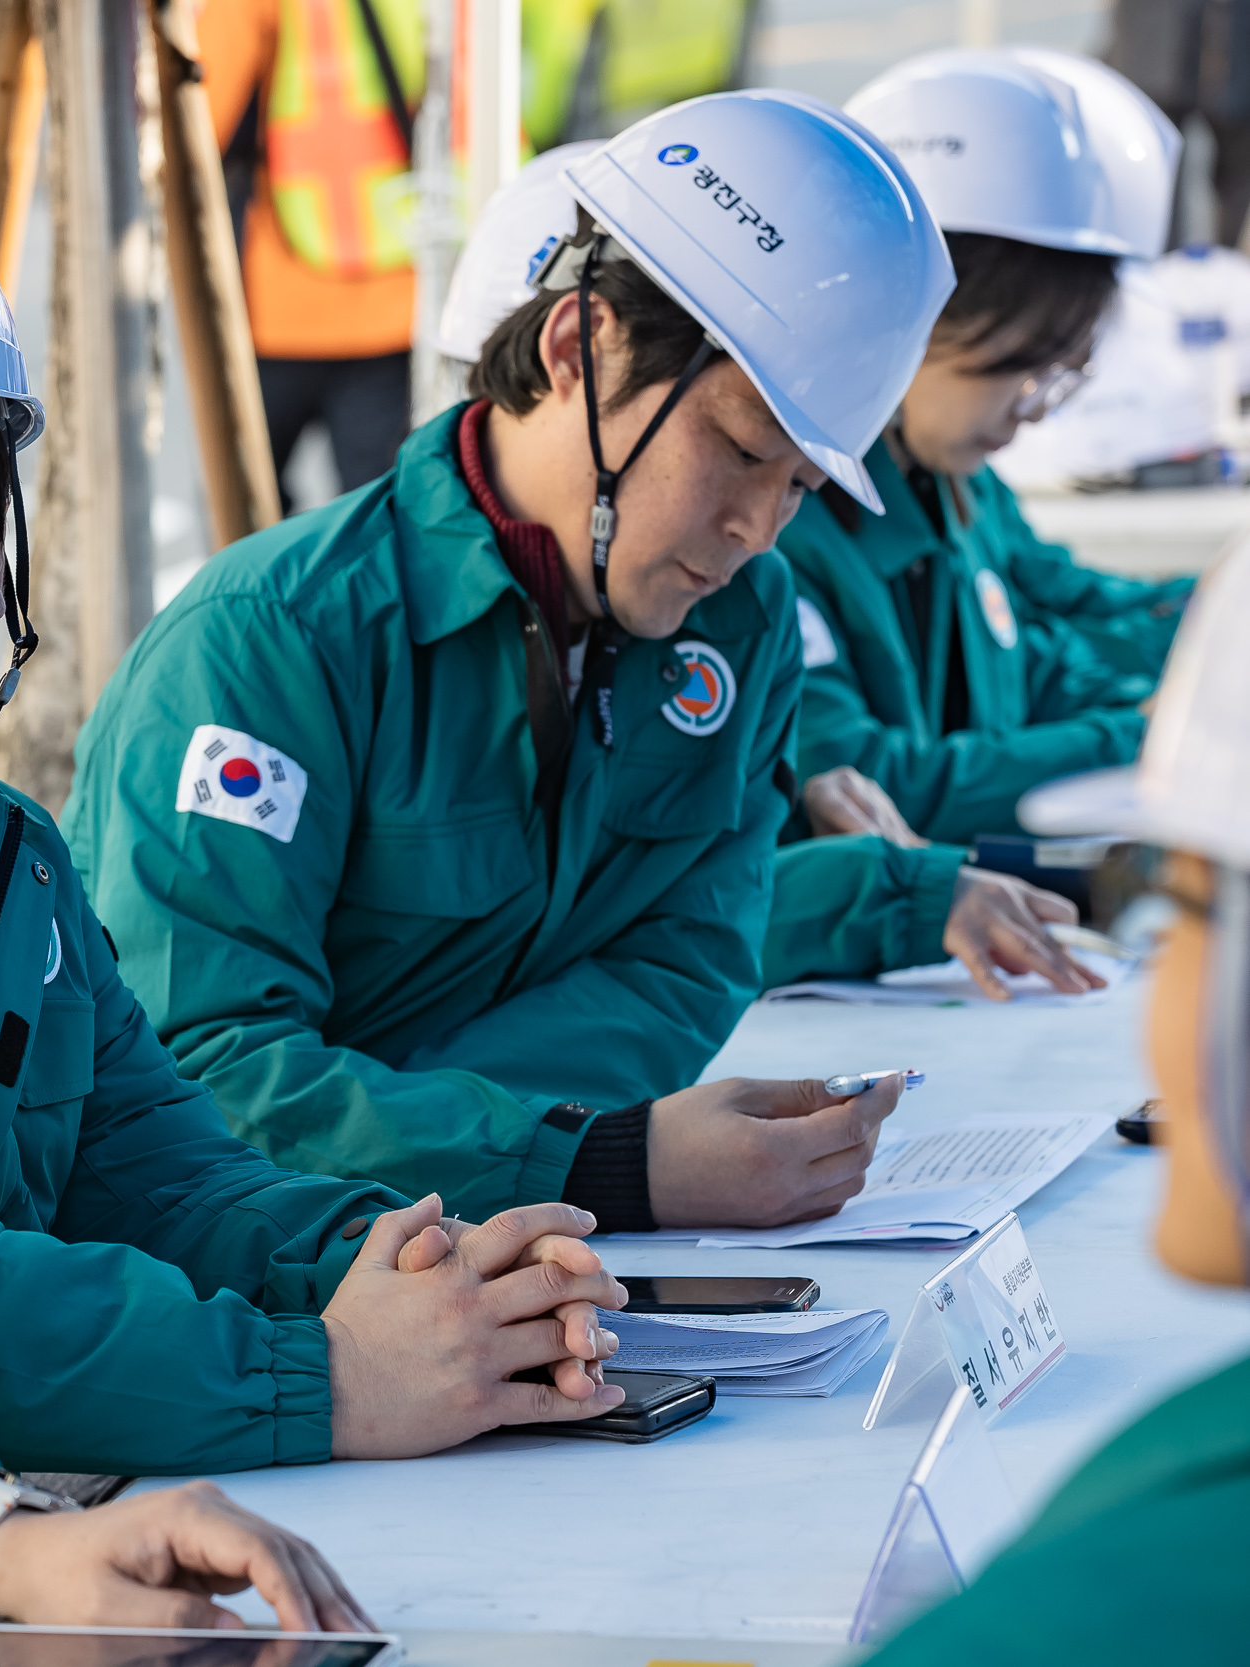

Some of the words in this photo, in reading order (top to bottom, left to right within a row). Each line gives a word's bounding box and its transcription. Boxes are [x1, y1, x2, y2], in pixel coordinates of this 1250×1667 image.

[693, 164, 785, 253] 광진구청
[1002, 1256, 1033, 1296] 통합지원본부
[962, 1293, 1057, 1409] 질서유지반
